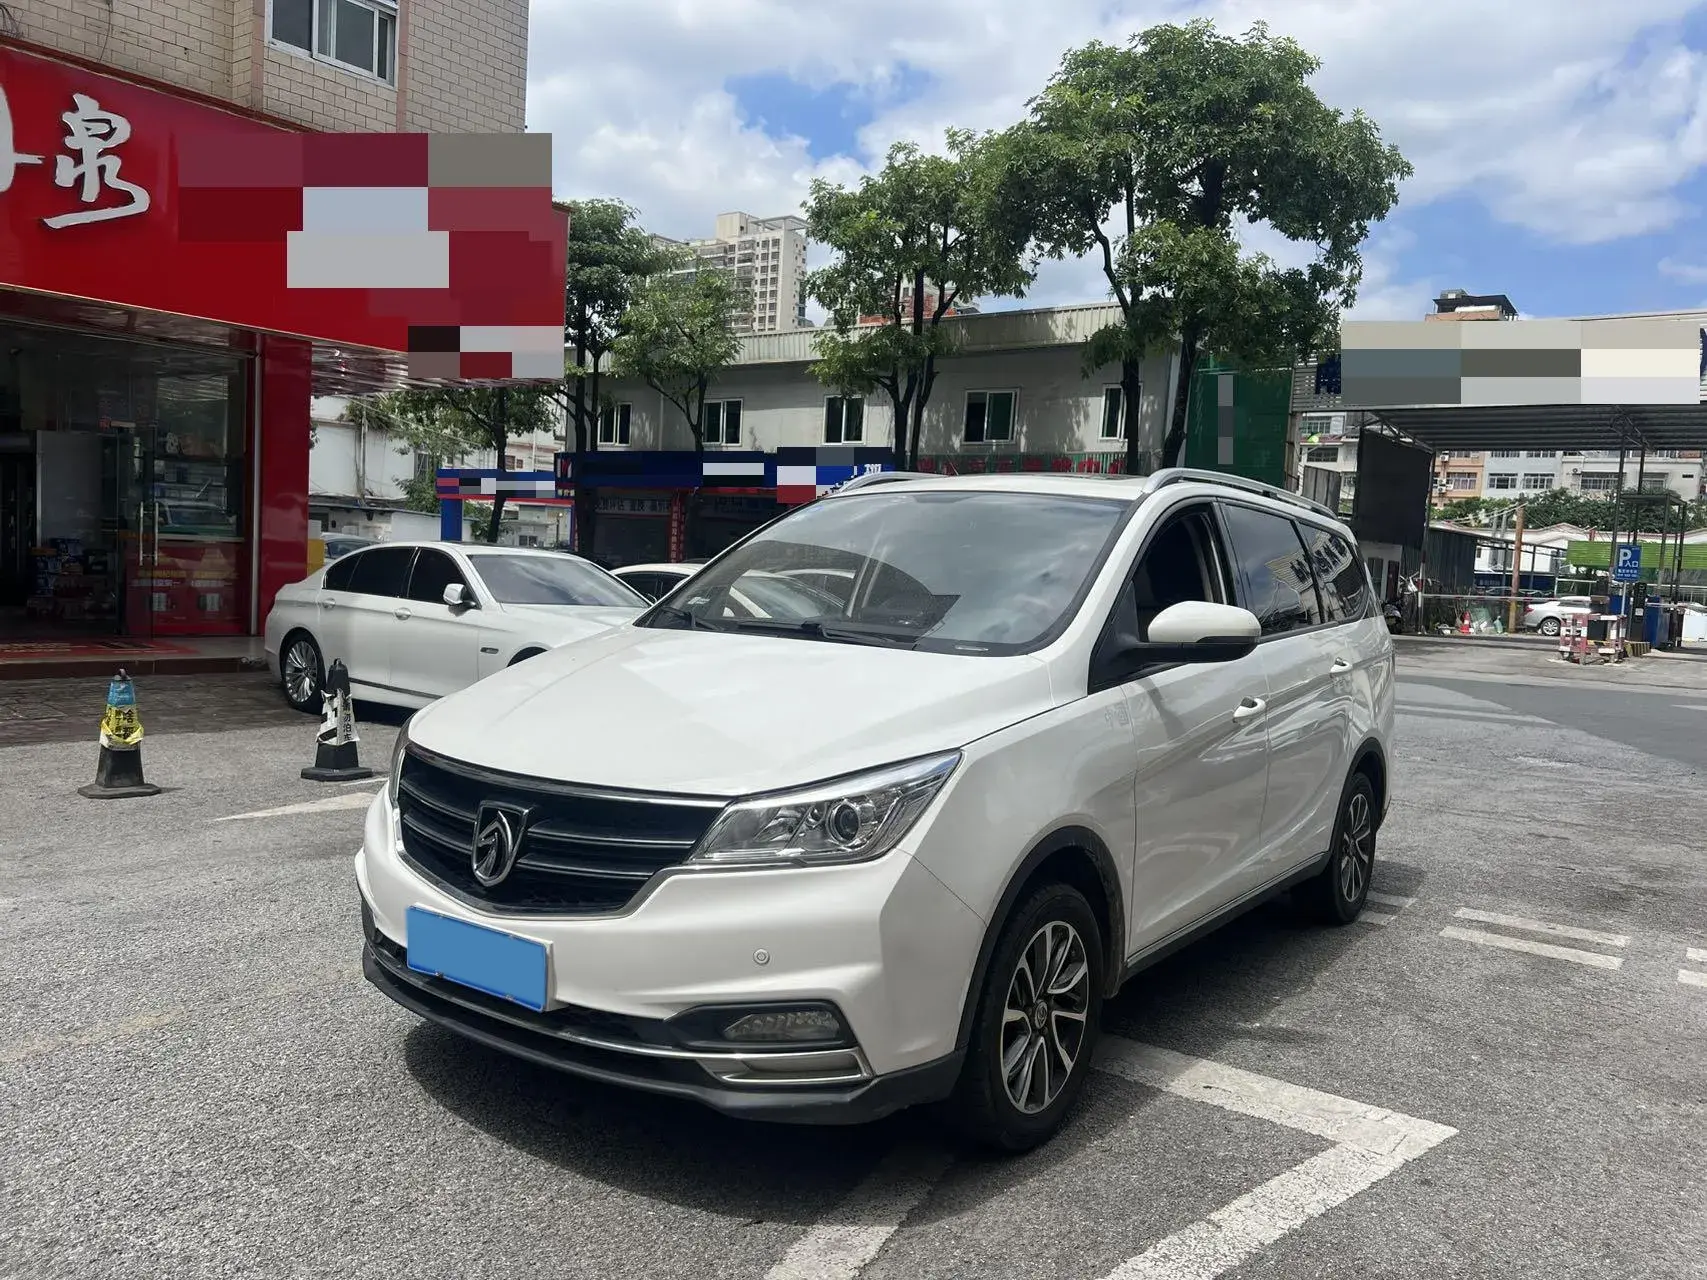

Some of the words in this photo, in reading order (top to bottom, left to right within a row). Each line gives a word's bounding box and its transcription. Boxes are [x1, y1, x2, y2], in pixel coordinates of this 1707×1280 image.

[0, 81, 151, 229] 泉
[1619, 548, 1632, 567] P
[1624, 560, 1639, 568] 入口
